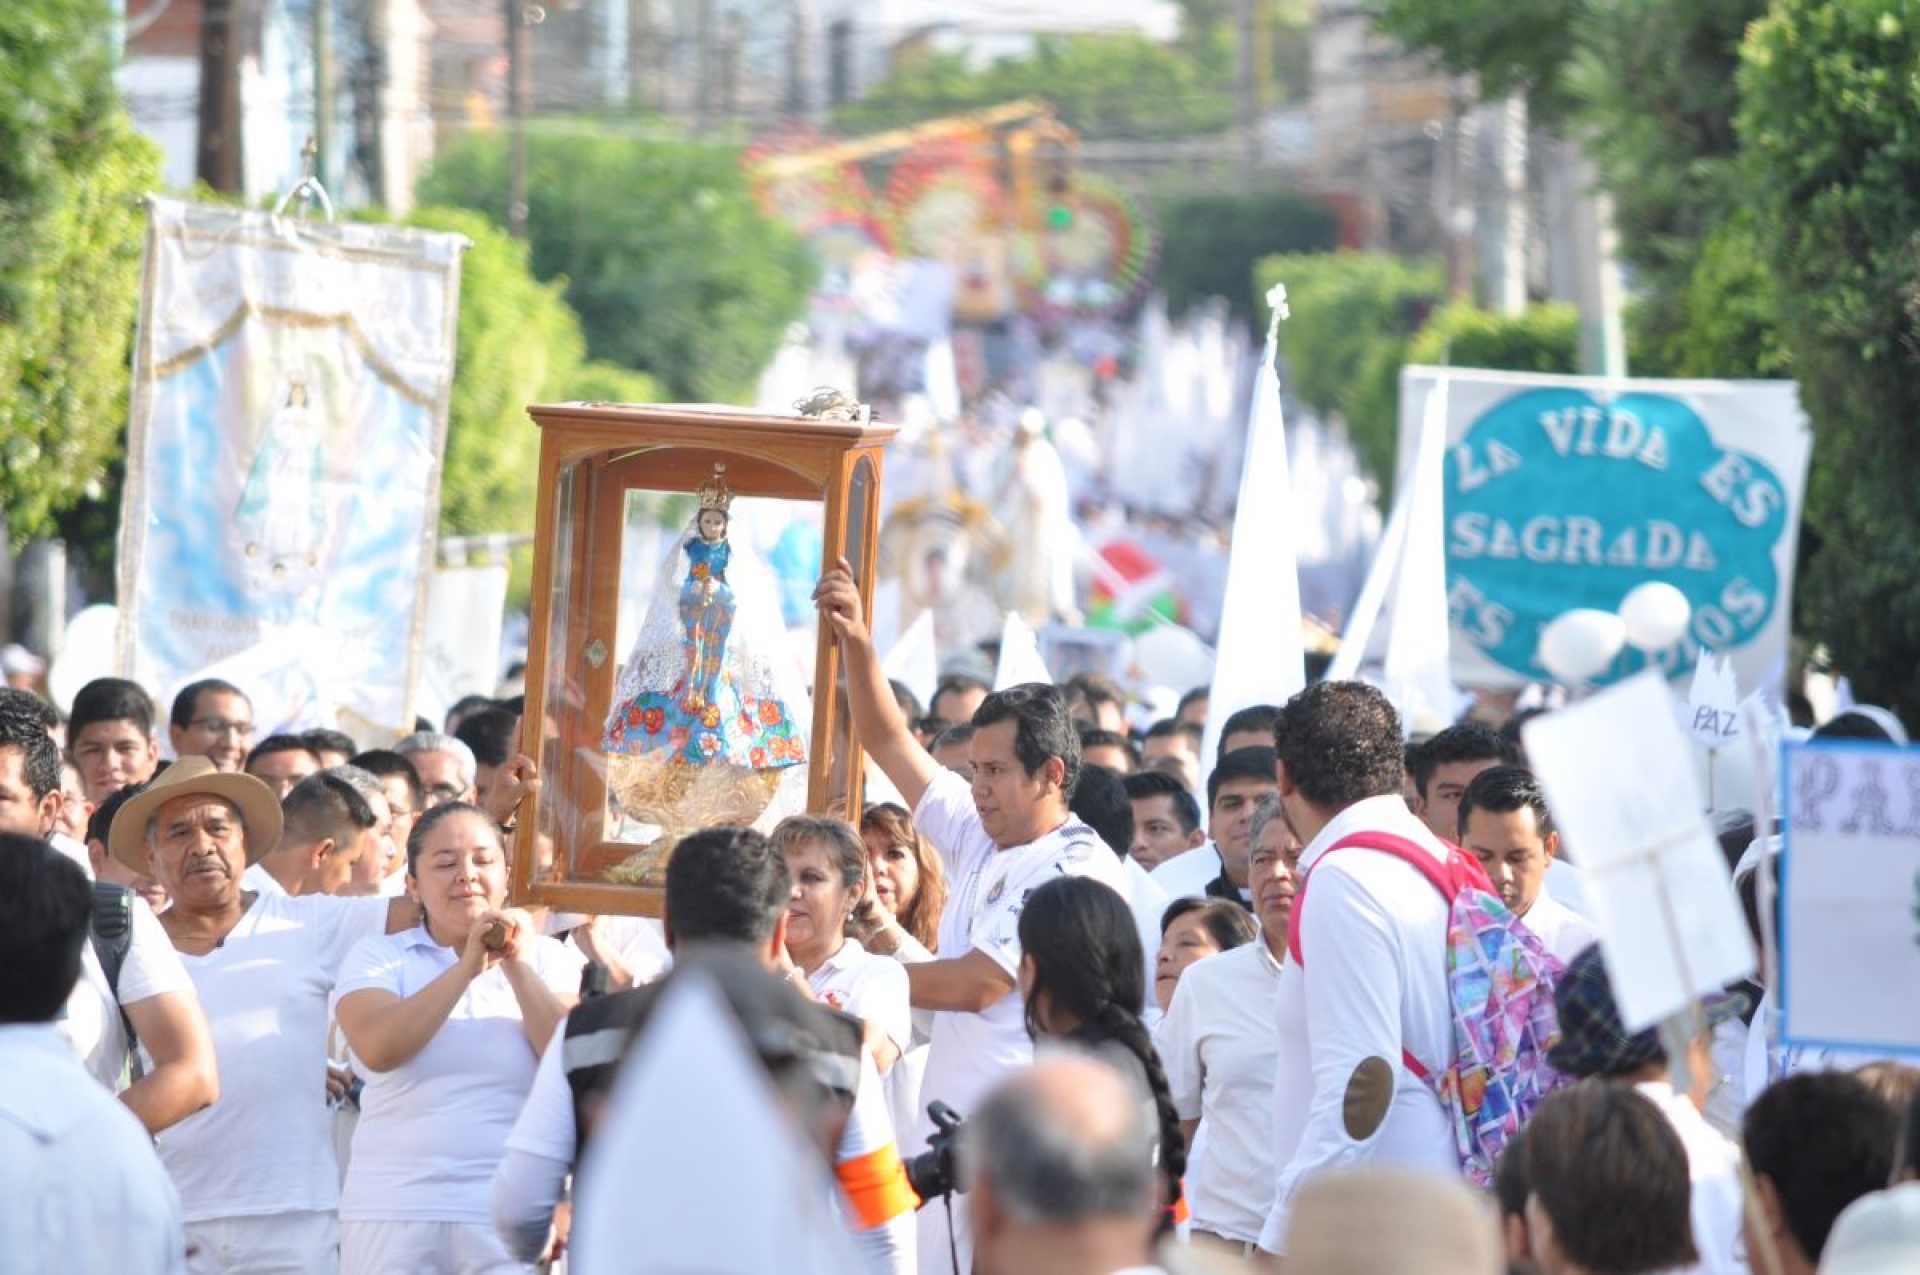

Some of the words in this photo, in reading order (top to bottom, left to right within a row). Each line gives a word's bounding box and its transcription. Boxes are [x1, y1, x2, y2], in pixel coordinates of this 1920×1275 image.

[1453, 440, 1522, 494] LA
[1539, 405, 1668, 471] VIDA
[1699, 451, 1781, 529] ES
[1450, 512, 1717, 571] SAGRADA
[1447, 575, 1515, 647] ES
[1692, 705, 1739, 737] PAZ
